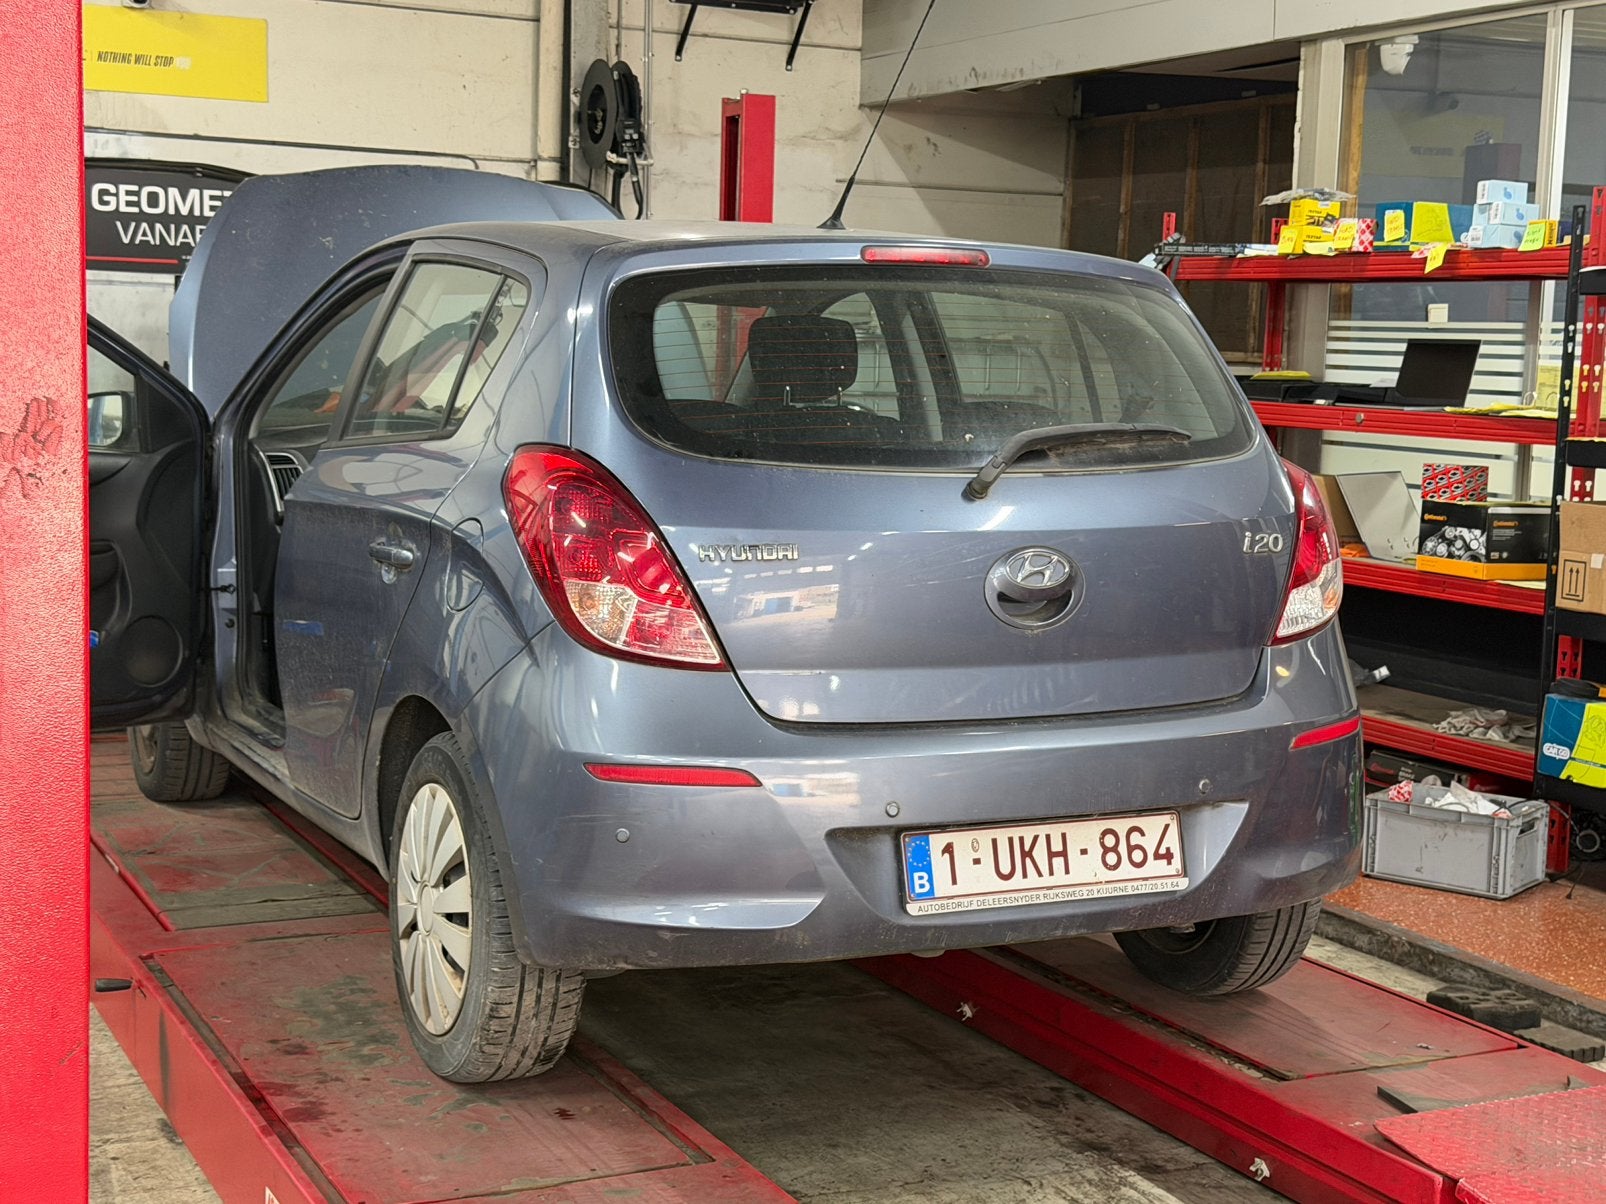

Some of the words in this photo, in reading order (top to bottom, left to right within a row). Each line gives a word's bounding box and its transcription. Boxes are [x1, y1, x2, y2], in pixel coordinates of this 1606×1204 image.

[97, 51, 132, 64] NOTHING
[134, 54, 152, 66] WILL
[153, 55, 174, 67] STOP
[698, 543, 799, 561] HYUNDAI
[1242, 531, 1284, 554] i20
[913, 871, 931, 894] B
[917, 900, 974, 913] AUTOBEDRIJF
[976, 893, 1041, 907] DELEERSNYDER
[1043, 888, 1084, 900] RIJKSWEG
[1086, 888, 1095, 896] 20
[1096, 885, 1129, 896] KUURNE
